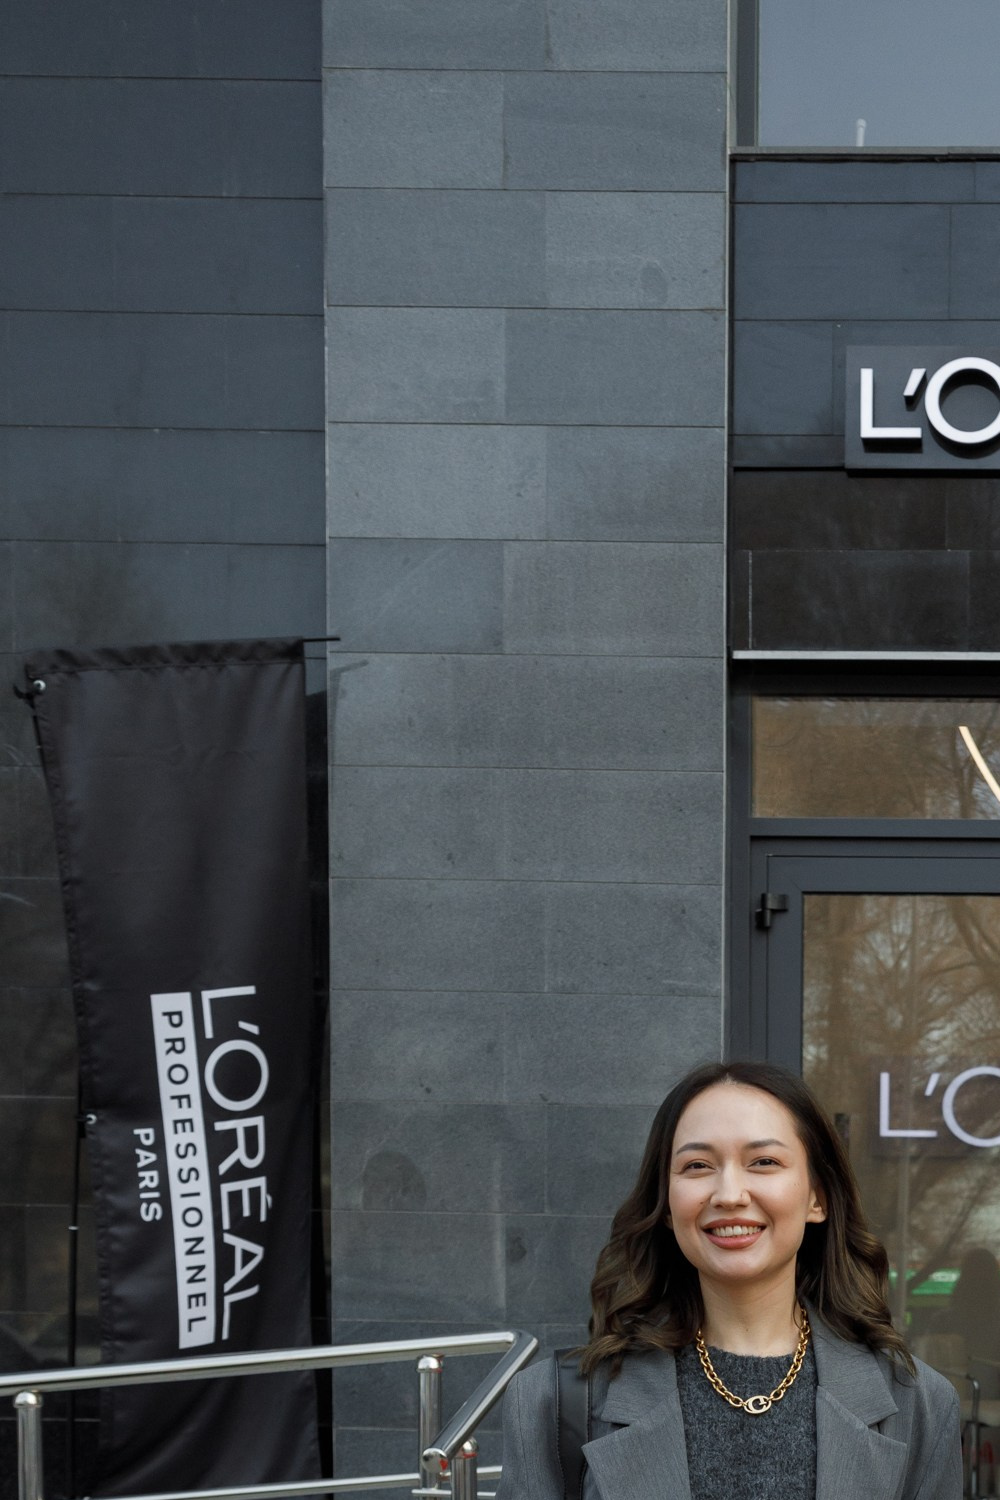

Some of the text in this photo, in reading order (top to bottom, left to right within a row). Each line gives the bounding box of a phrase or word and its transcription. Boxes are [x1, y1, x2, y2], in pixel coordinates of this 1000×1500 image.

[133, 1127, 163, 1223] PARIS
[161, 1010, 207, 1333] PROFESSIONNEL
[201, 985, 272, 1340] L'ORÉAL
